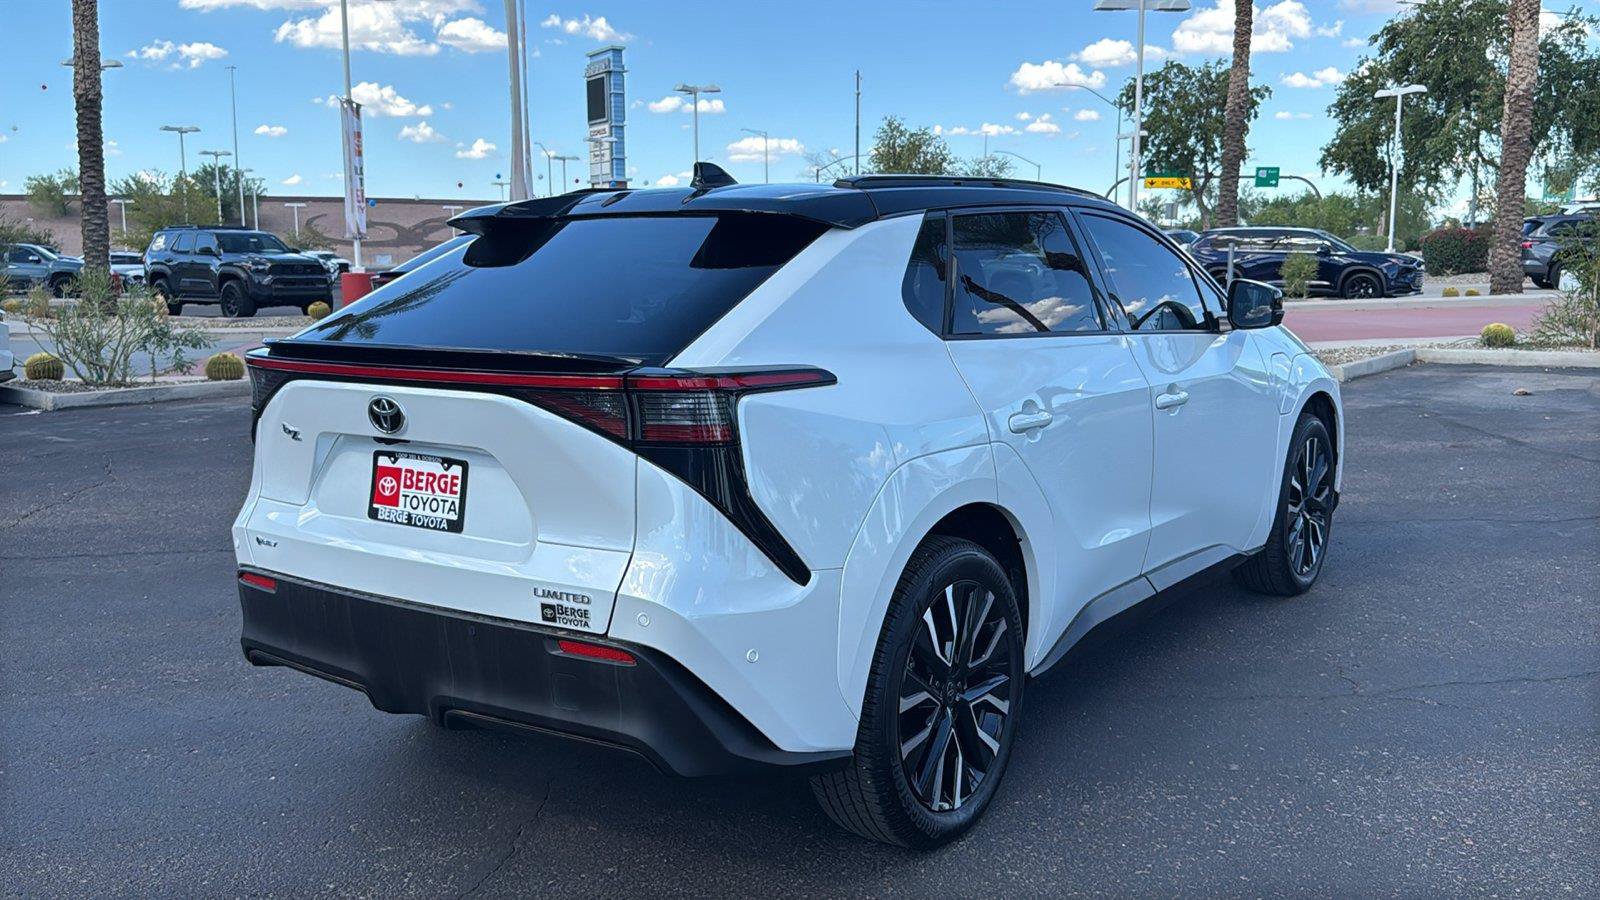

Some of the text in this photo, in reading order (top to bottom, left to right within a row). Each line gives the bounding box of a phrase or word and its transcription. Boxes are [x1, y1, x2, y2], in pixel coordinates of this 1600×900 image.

[403, 468, 460, 495] BERGE
[402, 494, 458, 516] TOYOTA
[378, 507, 448, 530] BERGE TOYOTA
[533, 587, 591, 605] LIMITED
[556, 604, 590, 618] BERGE
[557, 616, 591, 629] TOYOTA
